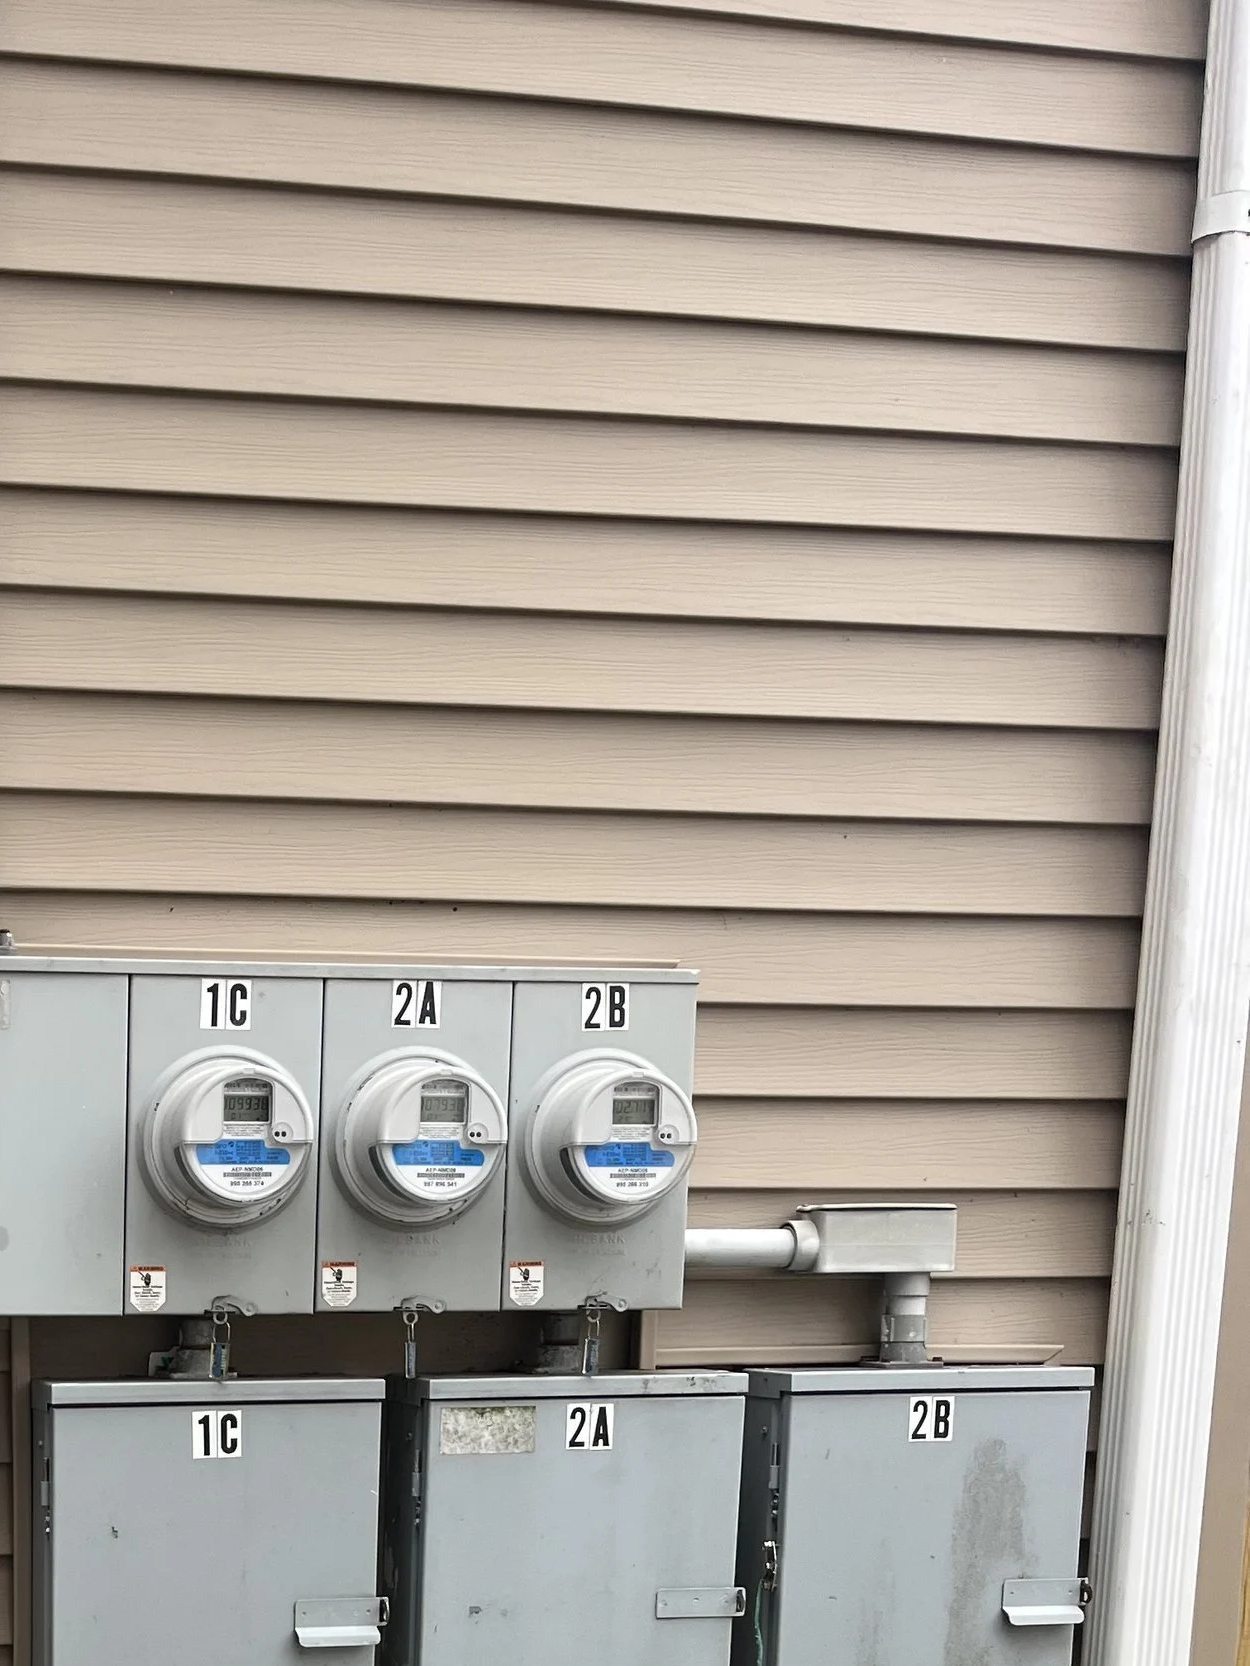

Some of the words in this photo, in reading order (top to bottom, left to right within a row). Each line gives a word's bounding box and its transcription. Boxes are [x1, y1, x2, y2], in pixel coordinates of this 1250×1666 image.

[206, 982, 247, 1027] 1C
[393, 981, 437, 1026] 2A
[583, 985, 625, 1029] 2B
[198, 1413, 237, 1456] 1C
[569, 1406, 610, 1448] 2A
[911, 1400, 950, 1440] 2B
